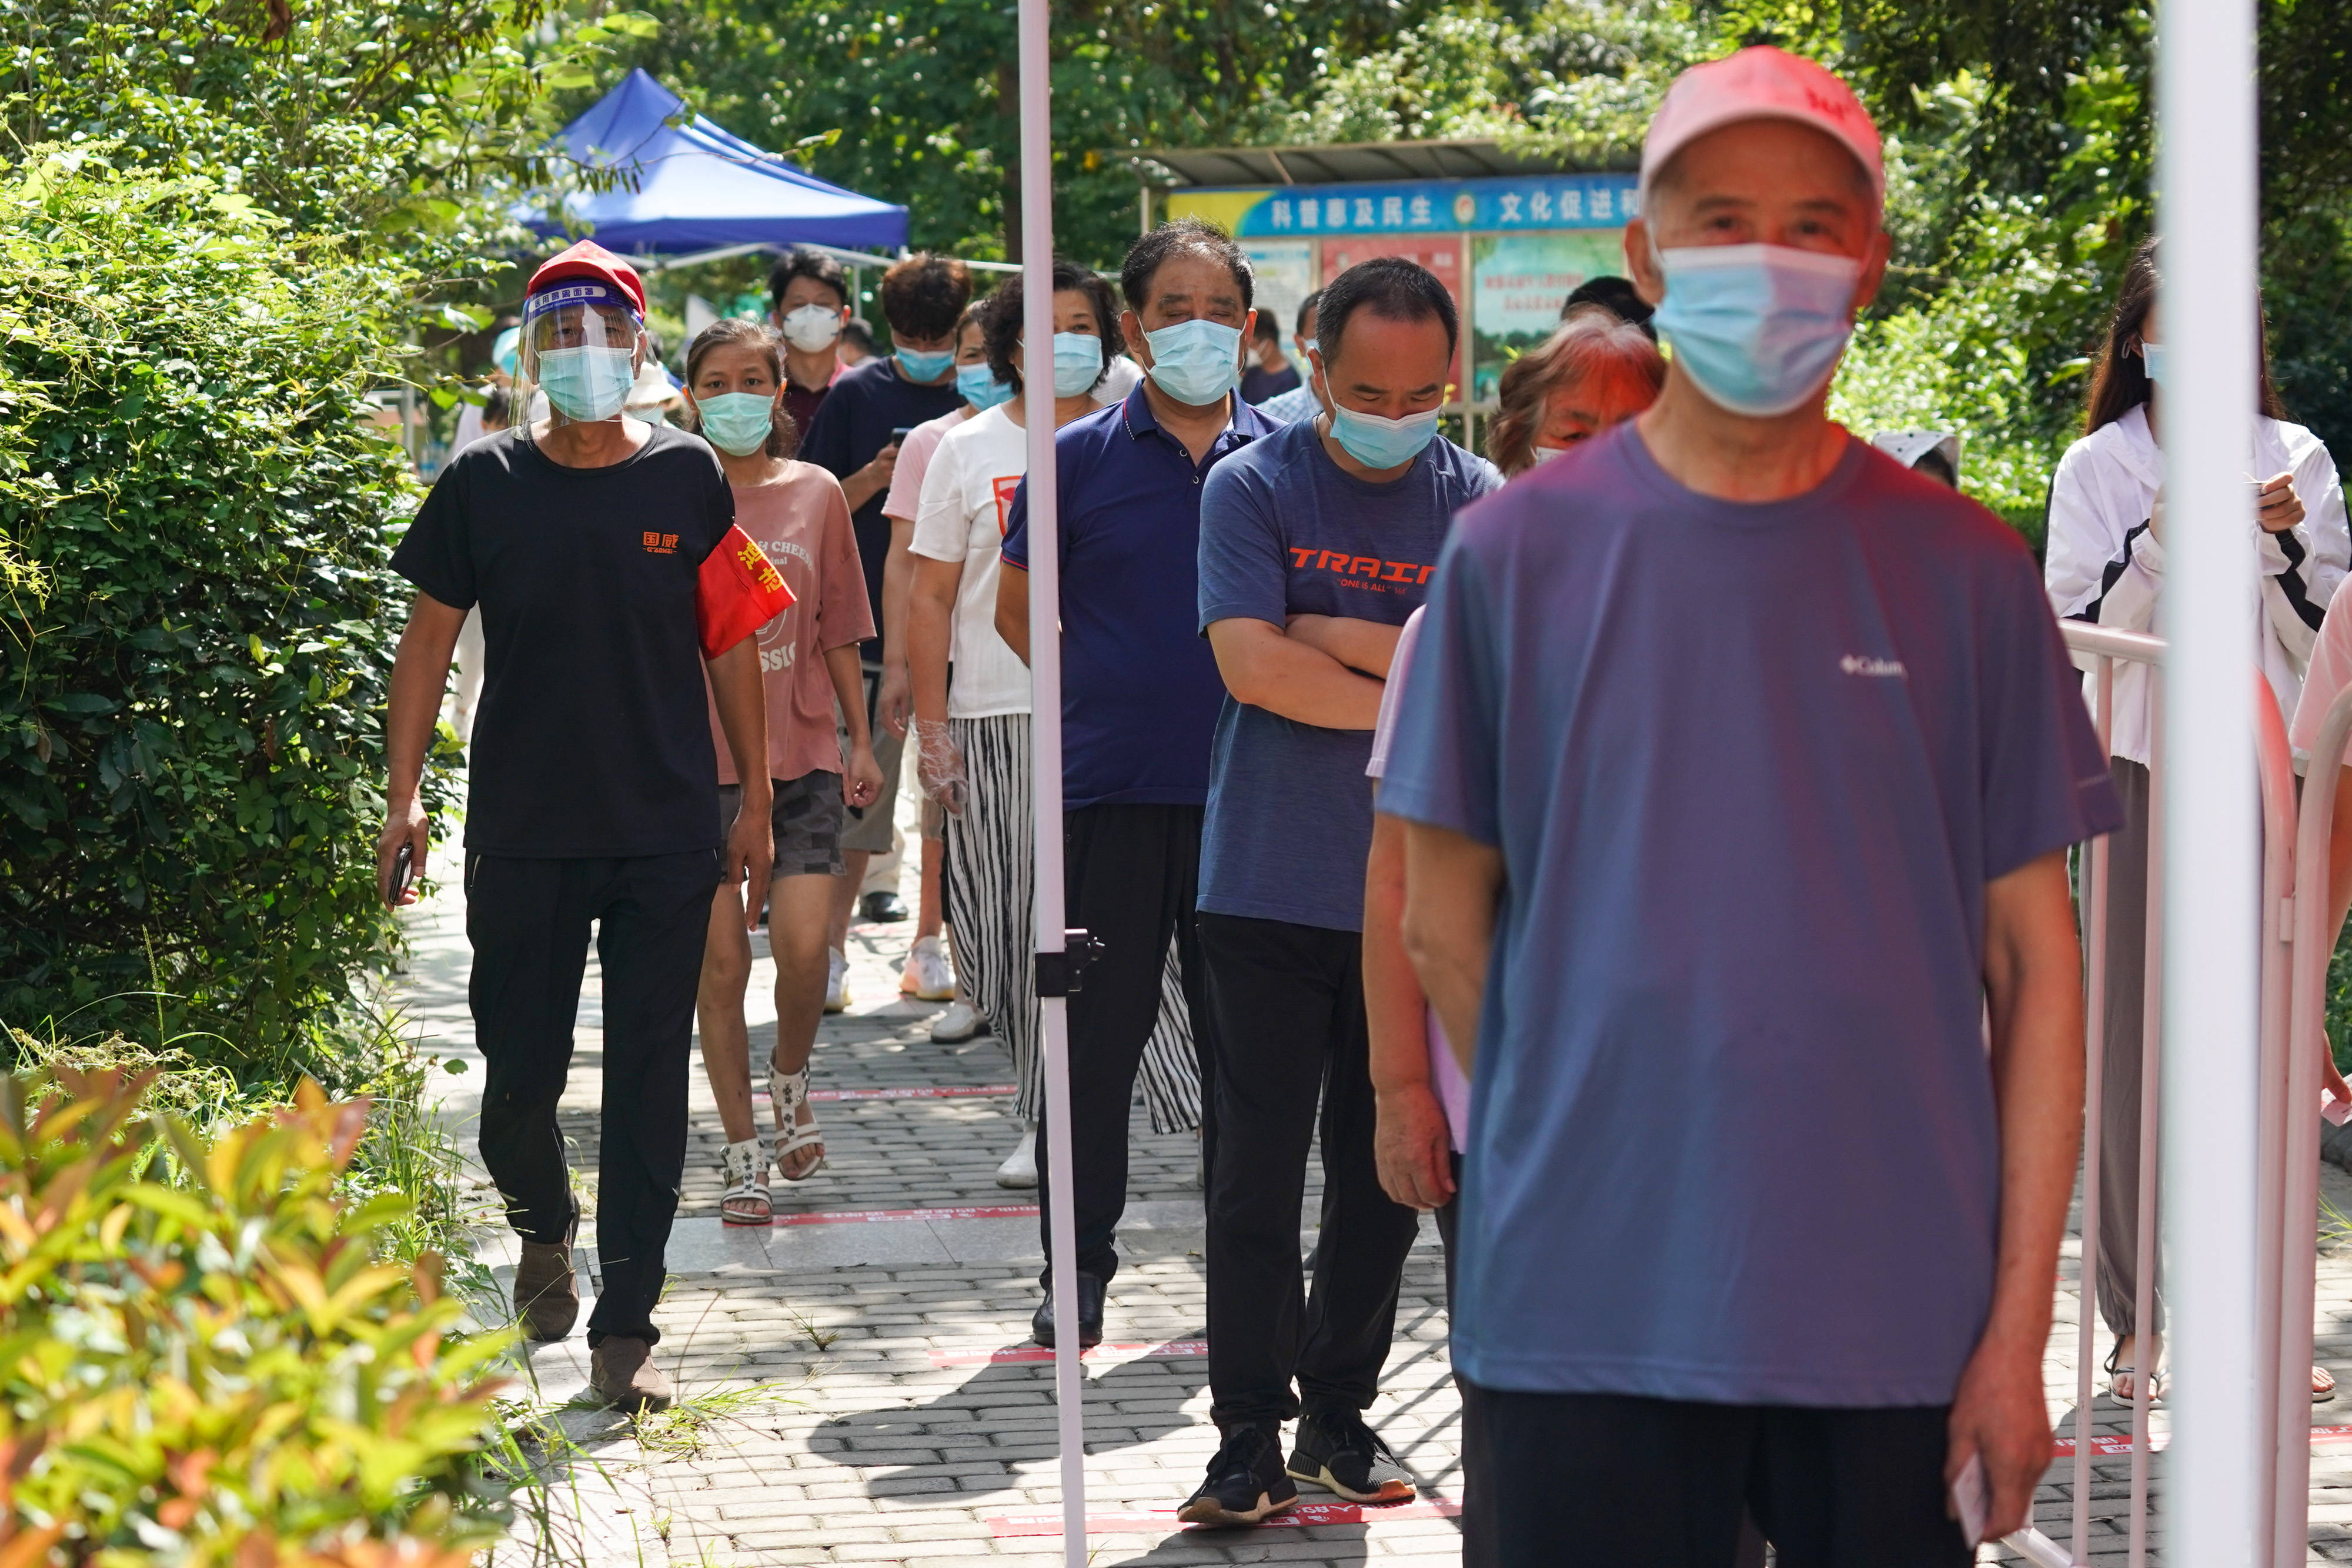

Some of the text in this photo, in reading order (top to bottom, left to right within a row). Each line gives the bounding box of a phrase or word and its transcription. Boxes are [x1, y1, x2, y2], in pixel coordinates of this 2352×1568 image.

[1271, 195, 1432, 228] 科普惠及民生
[643, 531, 679, 548] 国威
[771, 556, 788, 565] inal
[1361, 581, 1369, 590] IS
